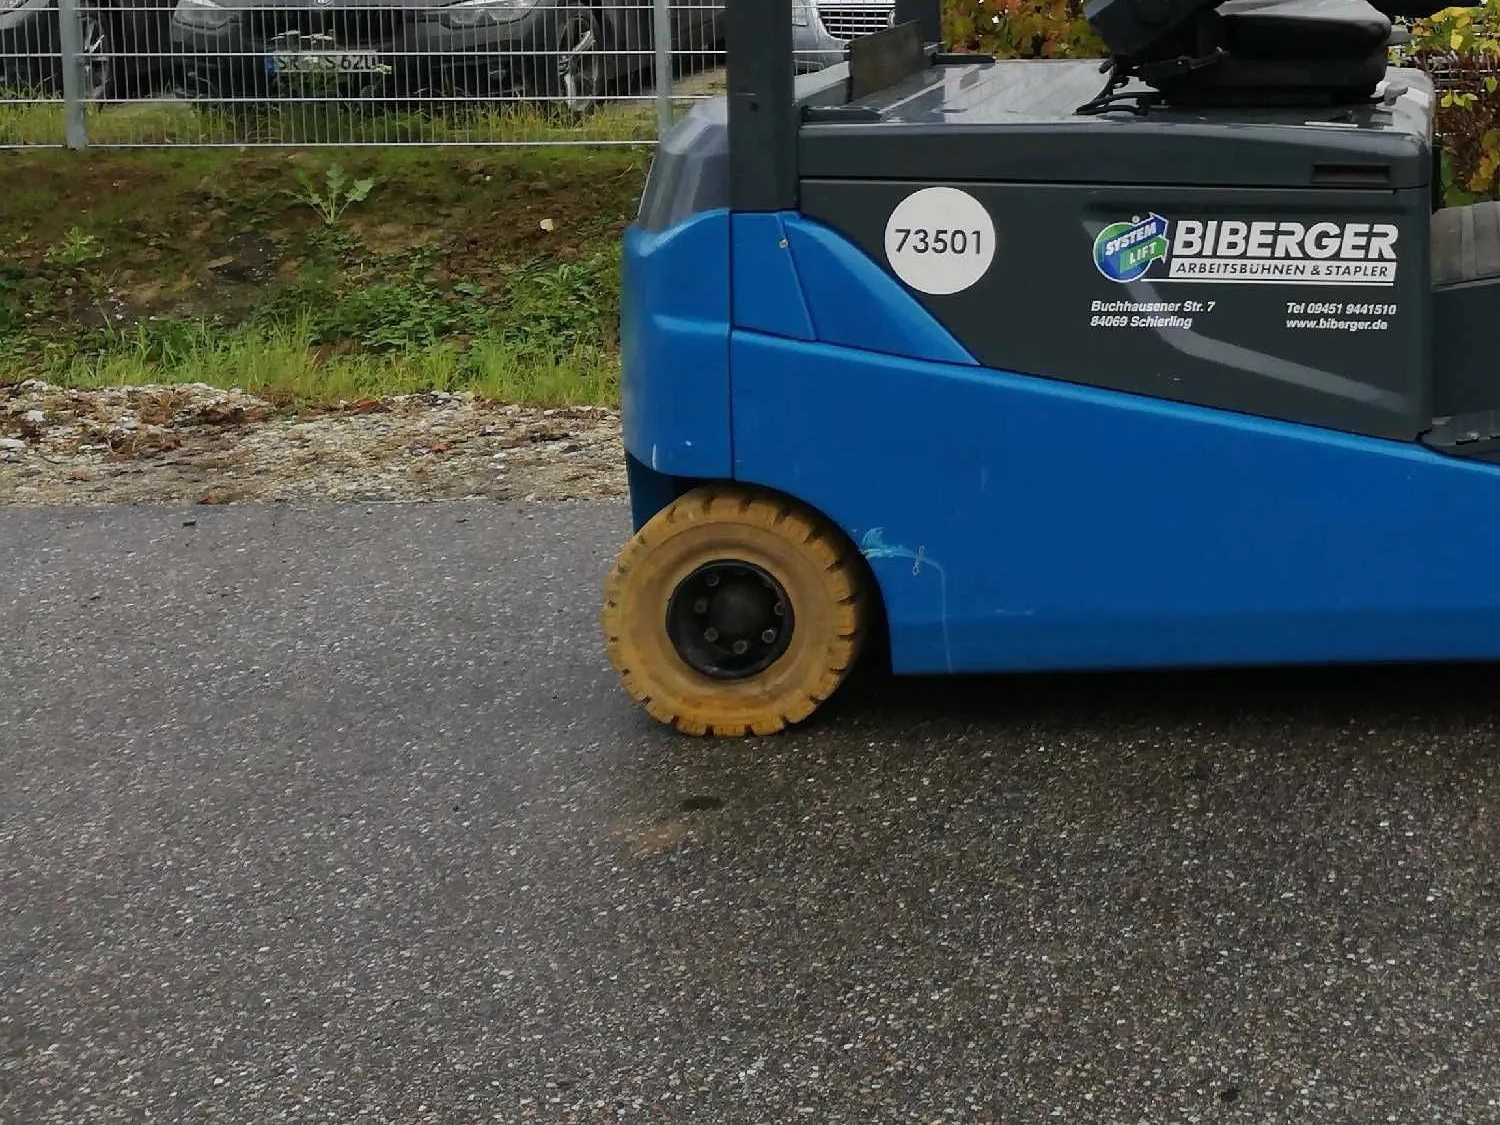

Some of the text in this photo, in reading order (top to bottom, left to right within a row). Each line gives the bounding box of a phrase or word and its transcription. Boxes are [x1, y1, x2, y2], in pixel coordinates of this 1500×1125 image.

[895, 229, 982, 255] 73501
[1104, 221, 1158, 256] SYSTEM
[1172, 220, 1399, 259] BIBERGER
[1128, 241, 1157, 265] LIFT
[1176, 261, 1388, 277] ARBEITSBÜHNEN & STAPLER
[1090, 300, 1216, 313] Buchhausener Str. 7
[1286, 302, 1397, 315] Tel 09451 9441510
[1090, 315, 1193, 330] 84069 Schierling
[1286, 318, 1389, 332] www.biberger.de
